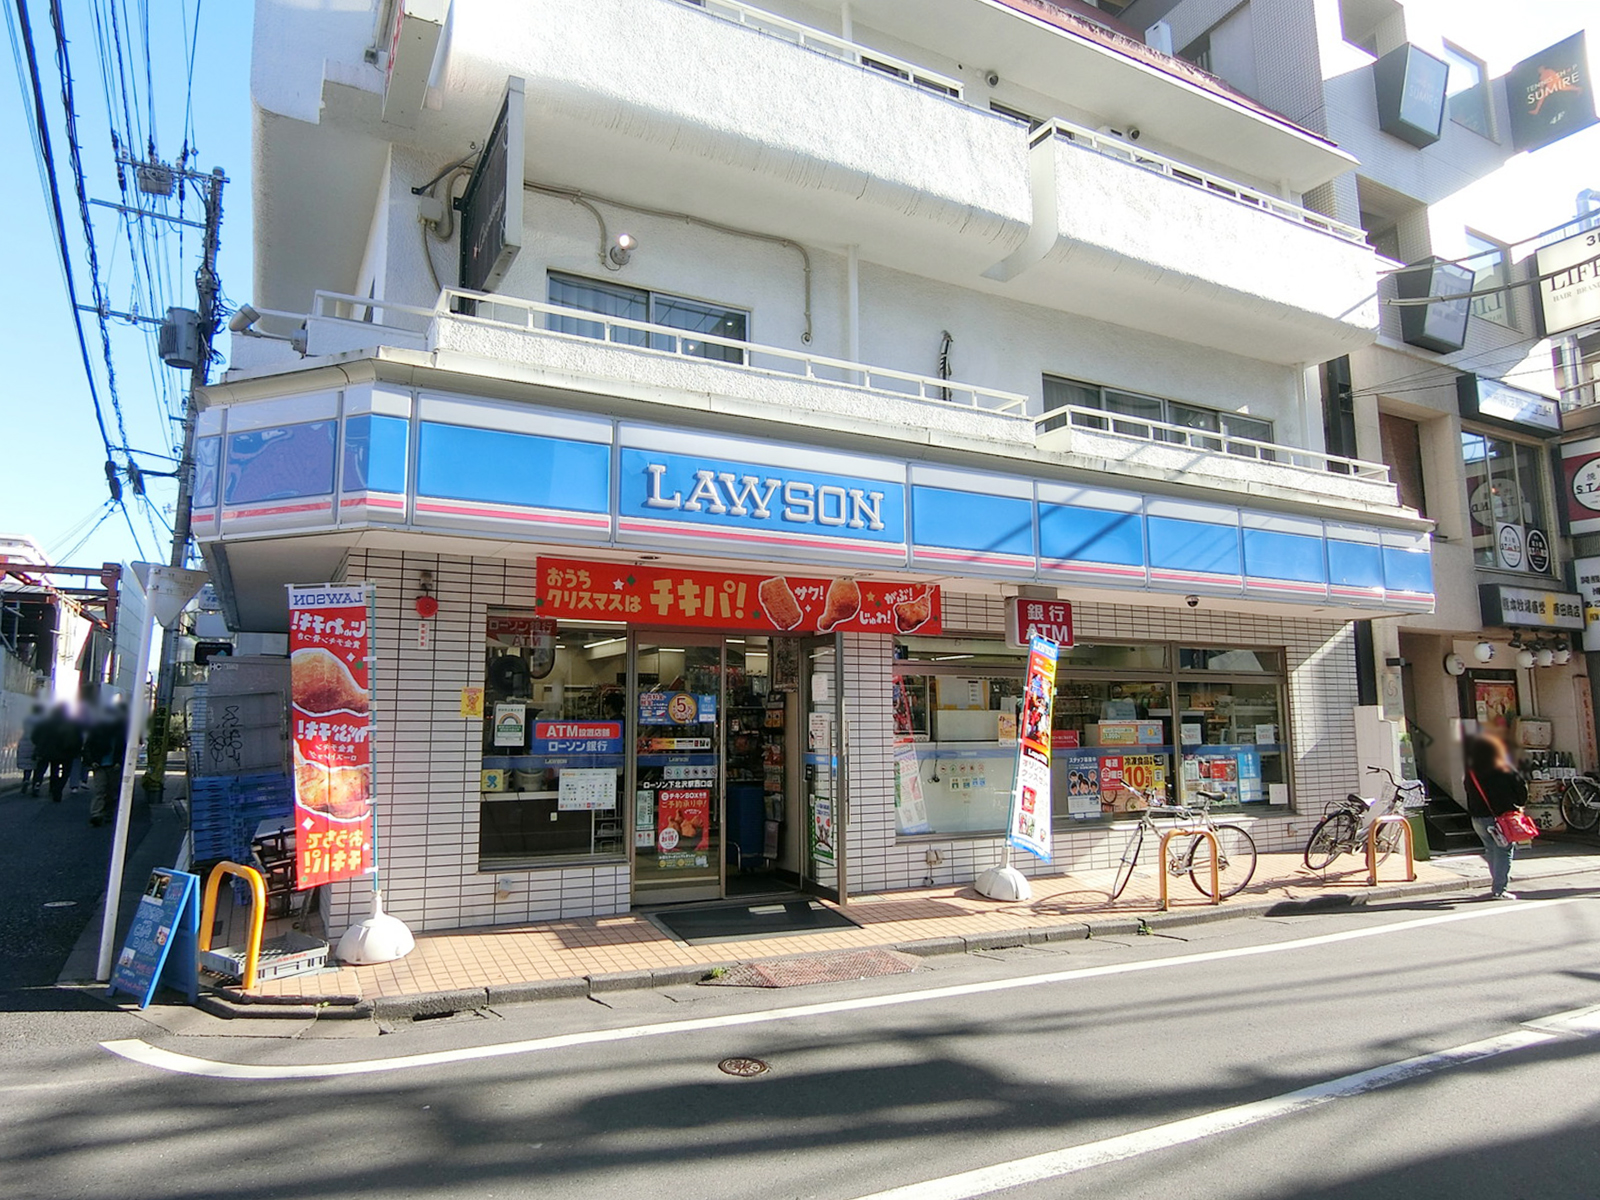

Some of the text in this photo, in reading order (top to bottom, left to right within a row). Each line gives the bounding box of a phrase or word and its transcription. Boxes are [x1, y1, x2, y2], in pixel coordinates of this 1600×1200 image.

[1527, 76, 1553, 92] TENNIS
[1527, 72, 1580, 104] SUMIRE
[1586, 233, 1600, 246] 3
[1553, 291, 1572, 302] HAIR
[647, 464, 885, 531] LAWSON
[547, 567, 591, 589] おうち
[547, 588, 642, 613] クリスマスは
[650, 579, 747, 619] チキパ!
[794, 585, 824, 601] サク!
[884, 587, 913, 605] がぶ!
[860, 610, 891, 625] じゅわ!
[1027, 603, 1064, 622] 銀行
[489, 620, 553, 633] ローソン銀行
[1025, 623, 1068, 642] ATM
[548, 741, 608, 752] ローソン銀行
